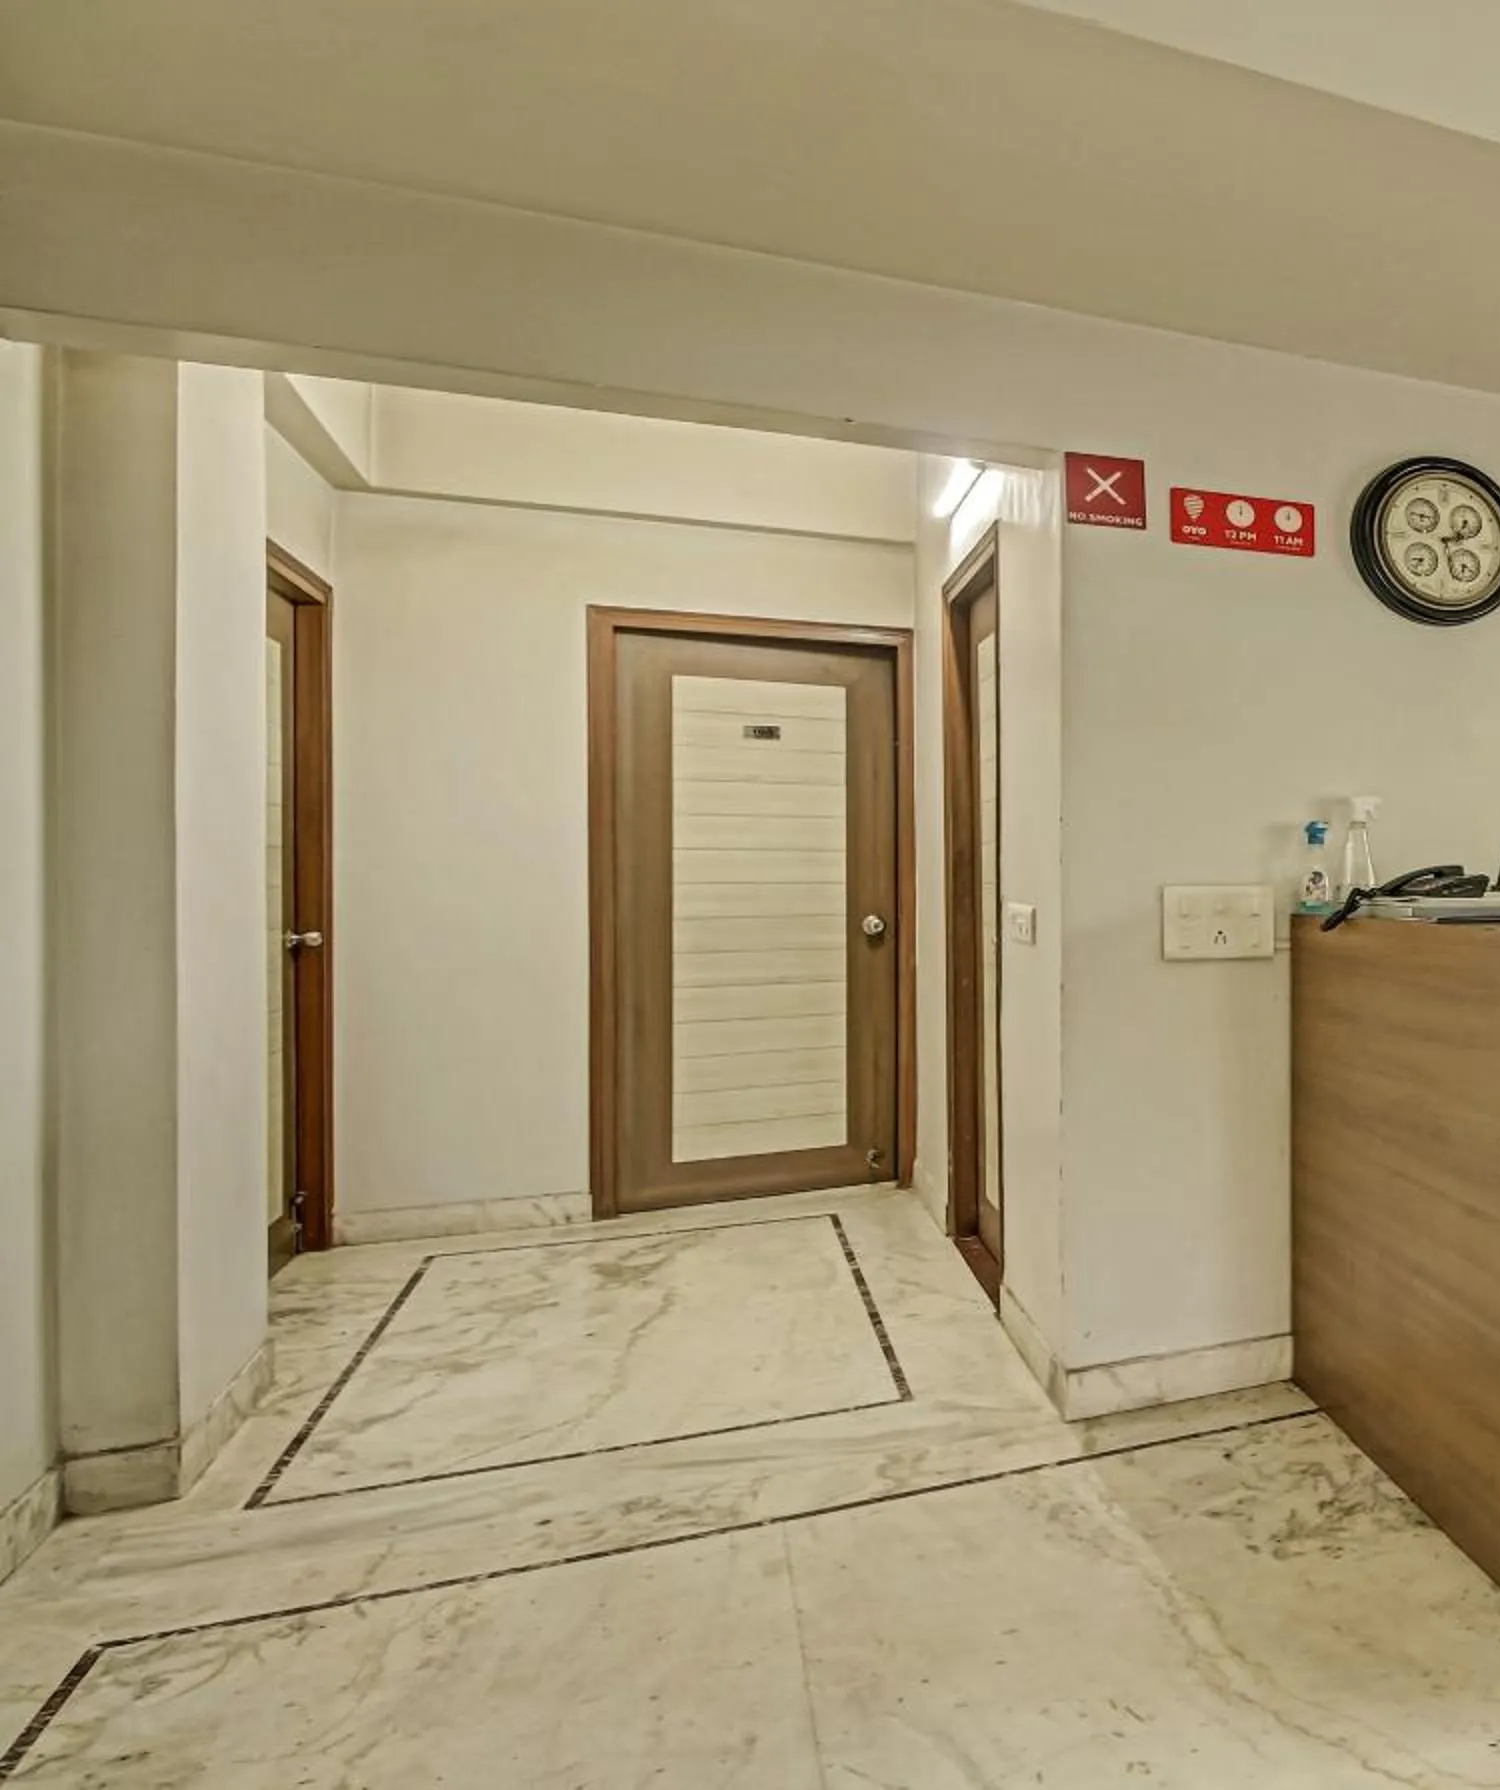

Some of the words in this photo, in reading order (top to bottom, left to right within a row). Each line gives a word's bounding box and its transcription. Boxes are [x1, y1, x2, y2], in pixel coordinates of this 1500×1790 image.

[1069, 511, 1086, 521] NO
[1088, 513, 1144, 527] SMOKING
[1181, 525, 1207, 536] OYO
[1224, 529, 1236, 540] 12
[1239, 531, 1257, 541] PM
[1285, 537, 1304, 546] AM
